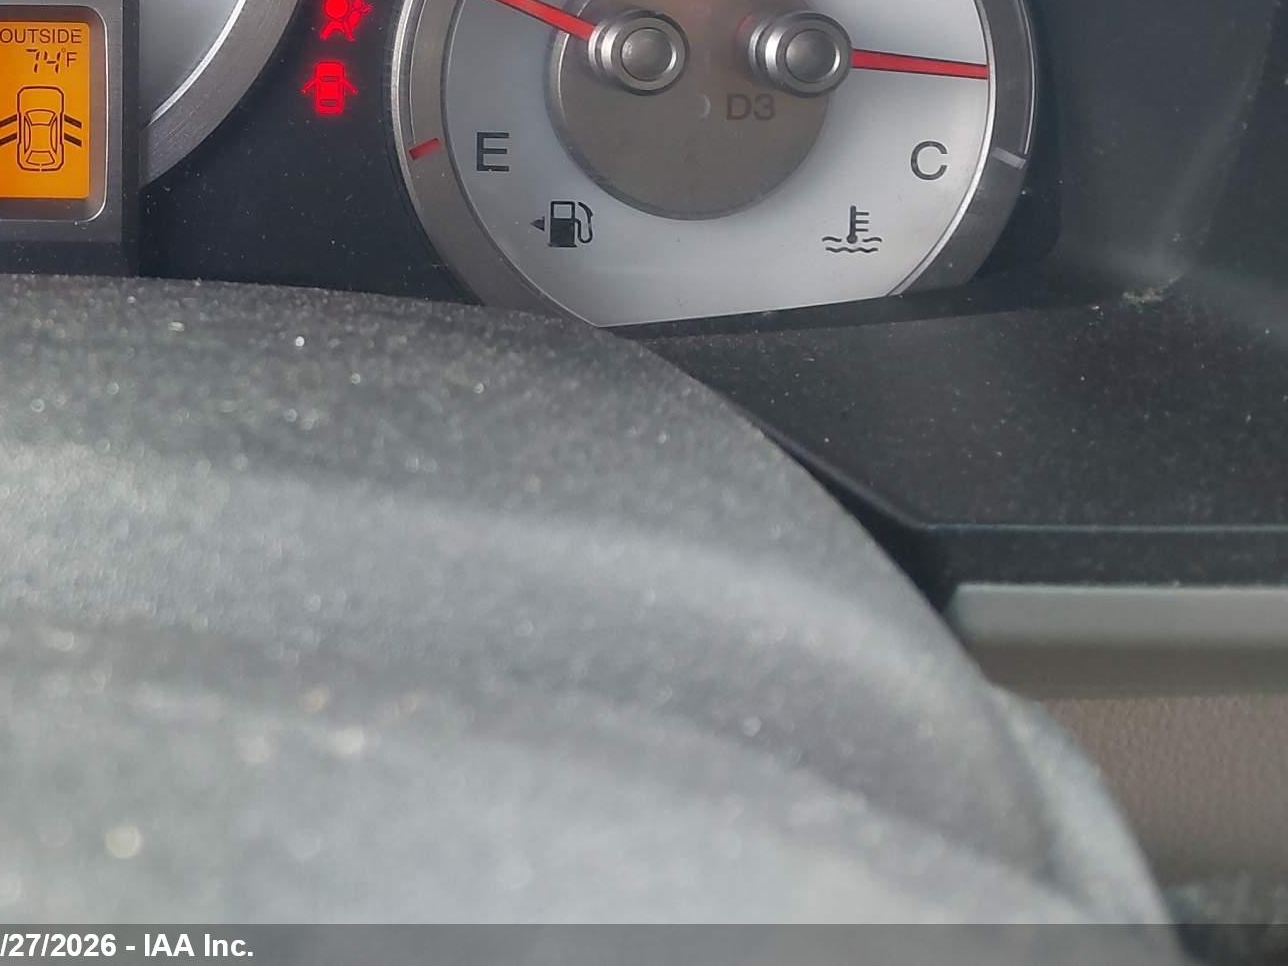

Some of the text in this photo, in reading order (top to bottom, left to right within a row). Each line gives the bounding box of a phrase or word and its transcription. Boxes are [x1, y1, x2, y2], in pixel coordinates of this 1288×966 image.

[0, 28, 82, 43] OUTSIDE
[727, 95, 775, 120] D3
[476, 132, 509, 172] E
[910, 141, 948, 180] C
